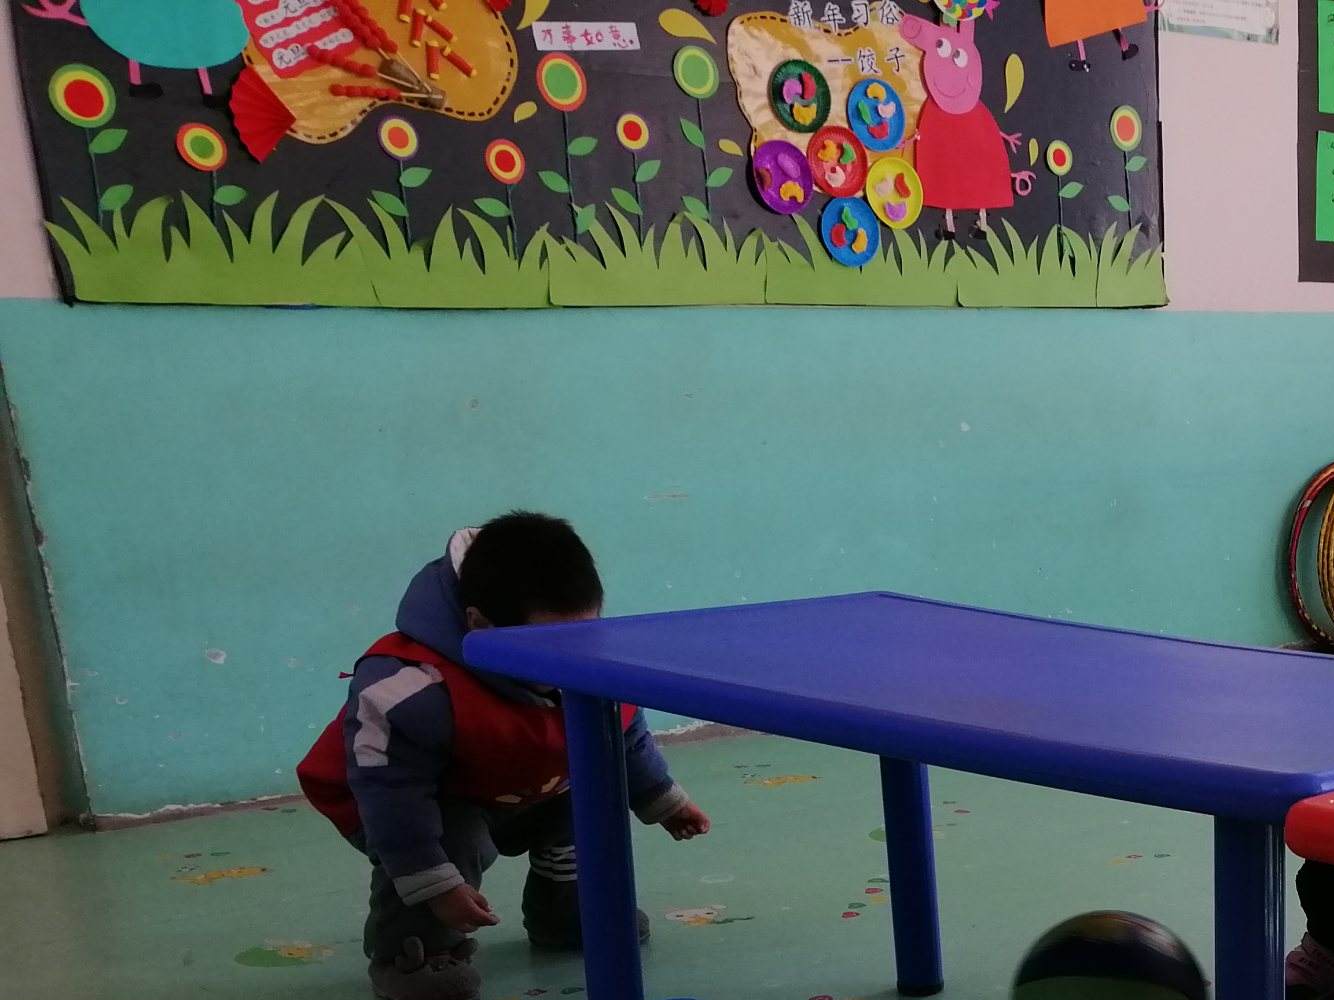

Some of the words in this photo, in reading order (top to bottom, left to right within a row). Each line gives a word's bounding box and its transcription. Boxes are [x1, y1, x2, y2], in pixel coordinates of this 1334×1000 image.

[788, 0, 900, 31] 新年习俗
[541, 24, 635, 49] 万事如意
